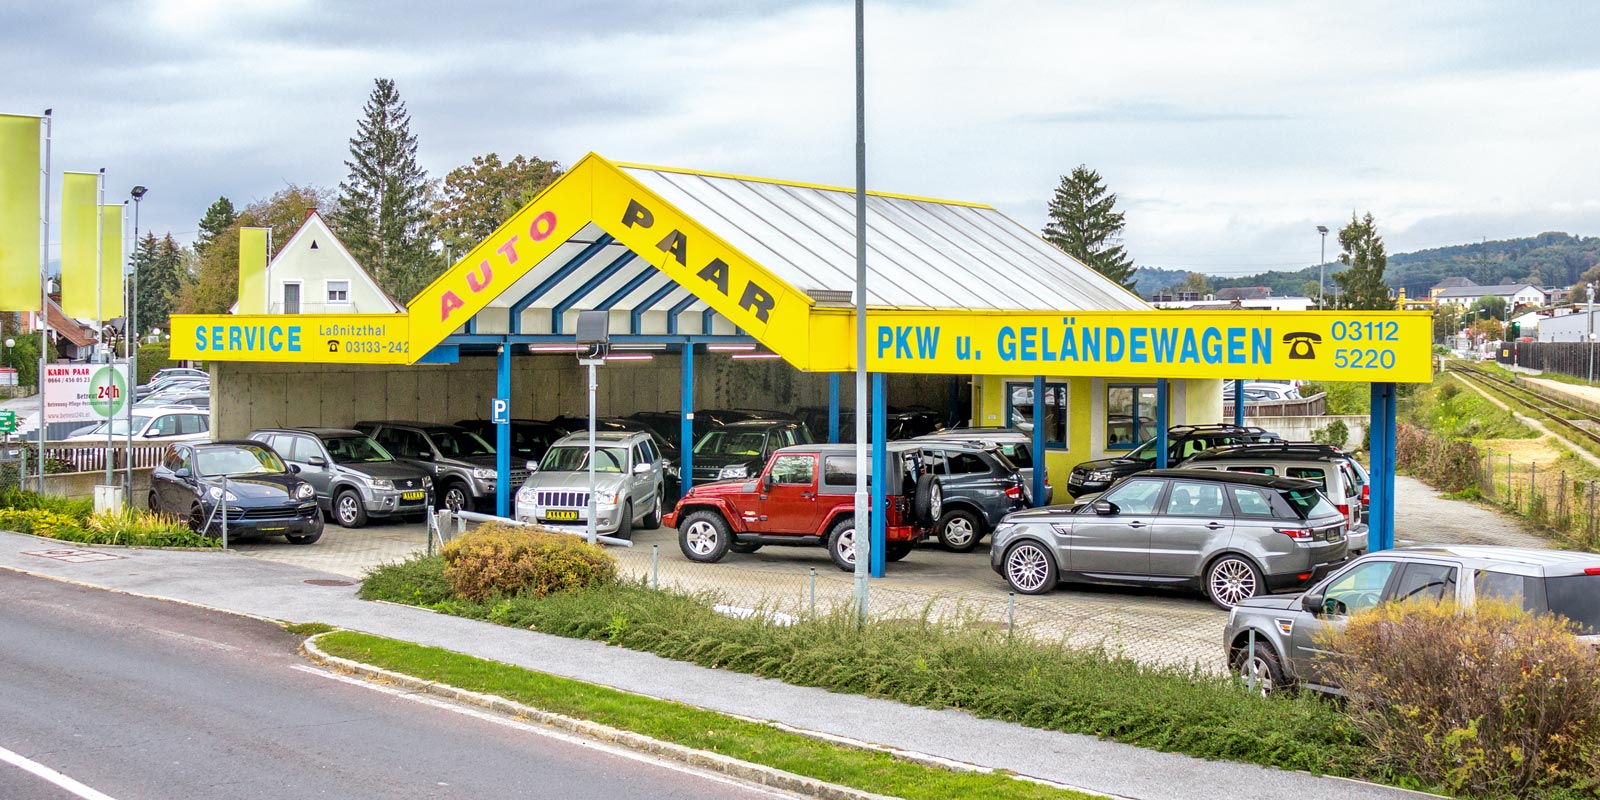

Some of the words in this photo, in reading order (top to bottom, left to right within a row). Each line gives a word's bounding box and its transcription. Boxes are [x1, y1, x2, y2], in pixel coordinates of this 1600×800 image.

[441, 210, 558, 322] AUTO
[621, 198, 776, 325] PAAR
[195, 325, 301, 352] SERVICE
[319, 324, 386, 337] Laßnitzthal
[877, 325, 941, 360] PKW
[956, 335, 981, 361] u.
[997, 317, 1272, 364] GELÄNDEWAGEN
[1331, 320, 1399, 342] 03112
[1334, 348, 1396, 369] 5220
[494, 400, 507, 419] P
